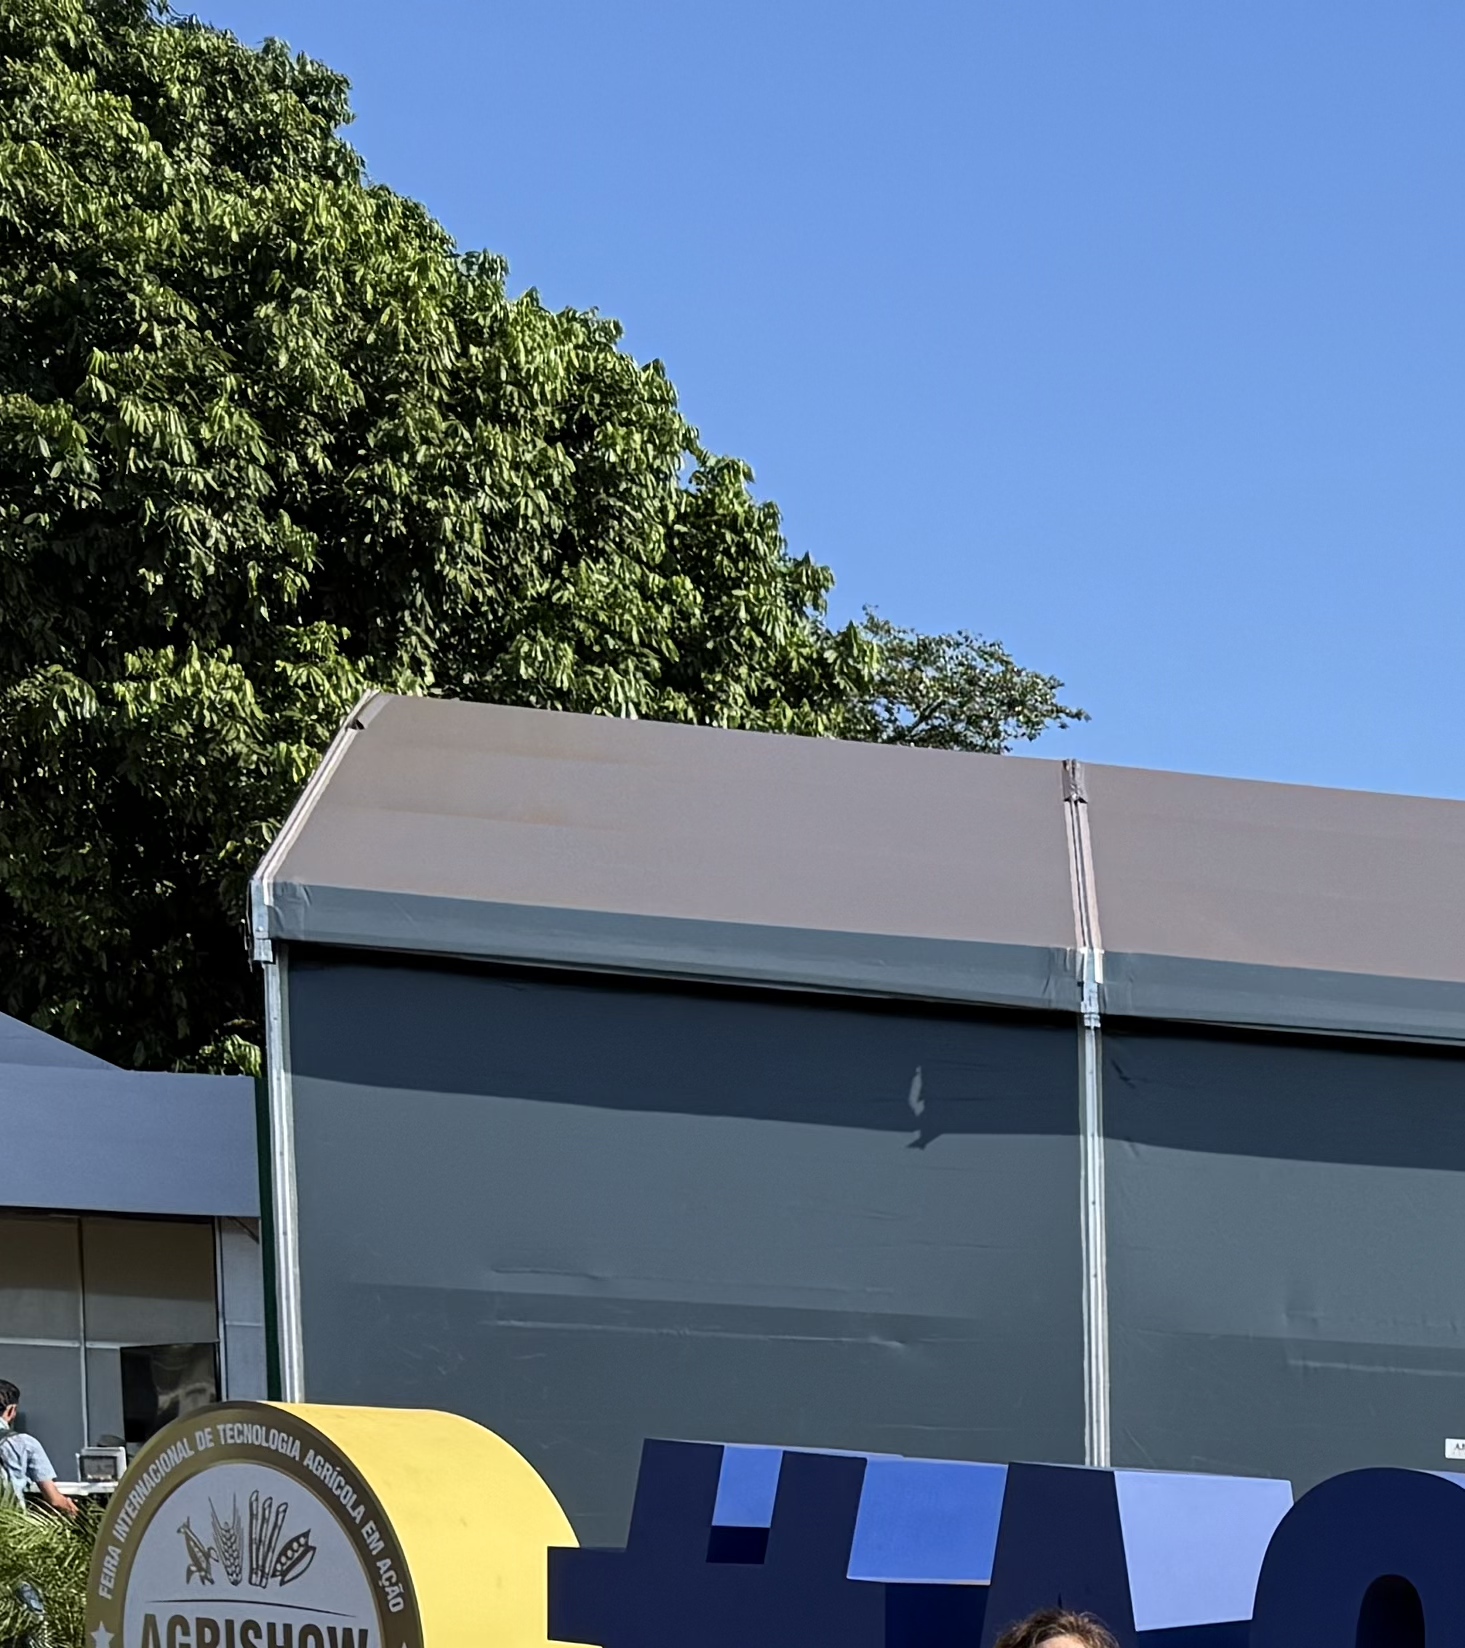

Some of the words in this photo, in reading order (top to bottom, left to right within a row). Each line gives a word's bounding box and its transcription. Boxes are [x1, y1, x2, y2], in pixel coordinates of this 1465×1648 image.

[99, 1545, 122, 1600] FEIRA
[112, 1438, 195, 1544] INTERNACIONAL
[195, 1430, 215, 1452] DE
[217, 1422, 301, 1461] TECNOLOGIA
[303, 1449, 363, 1525] AGRÍCOLA
[360, 1522, 386, 1556] EM
[376, 1559, 405, 1614] AÇÃO
